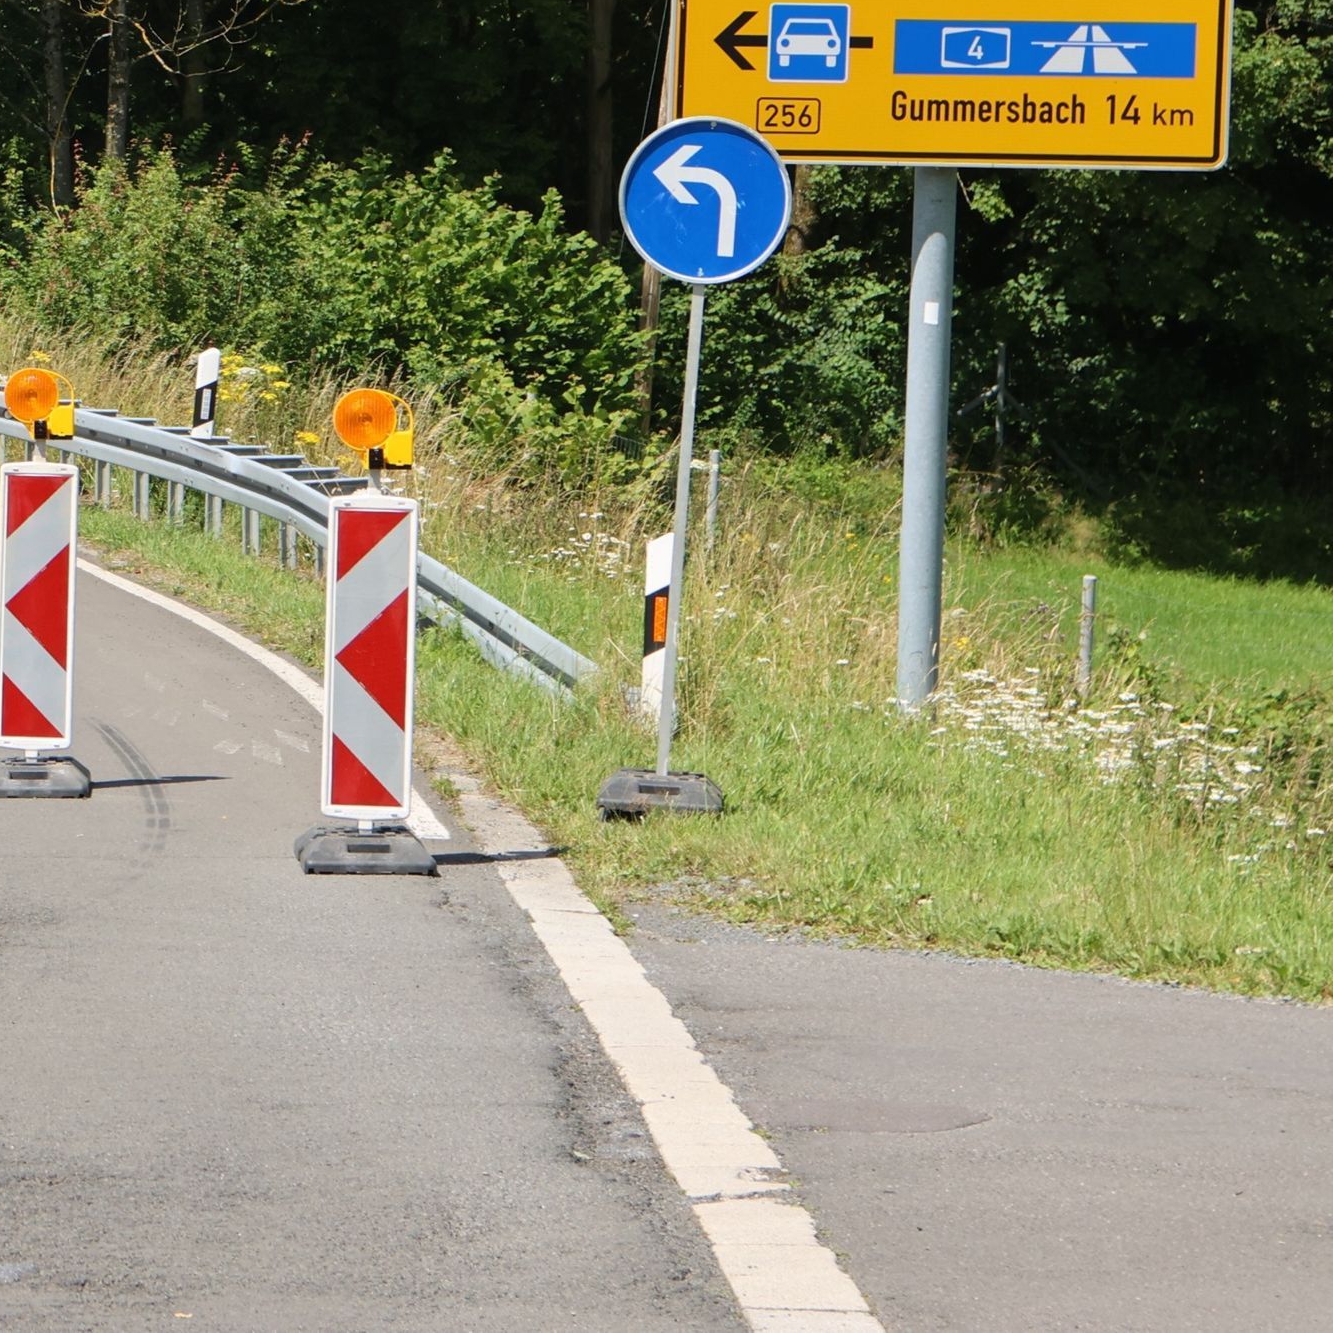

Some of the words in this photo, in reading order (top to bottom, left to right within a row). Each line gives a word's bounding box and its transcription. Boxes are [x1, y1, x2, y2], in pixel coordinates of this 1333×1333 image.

[968, 35, 984, 60] 4
[764, 103, 812, 128] 256
[891, 90, 1086, 125] Gummersbach
[1106, 94, 1141, 125] 14
[1152, 102, 1194, 127] km
